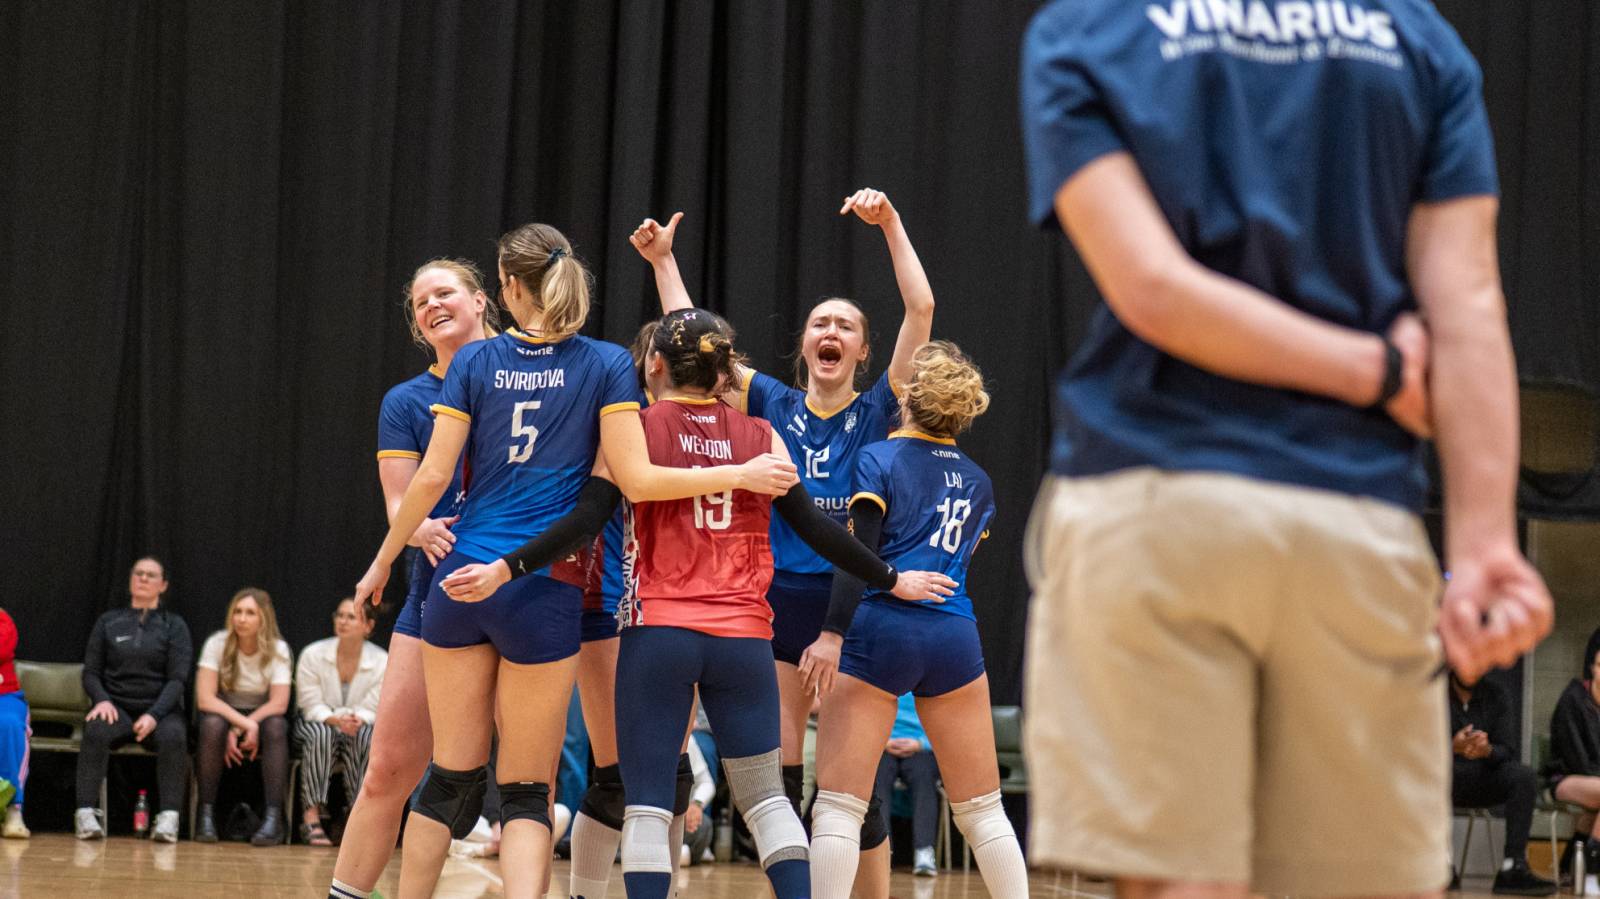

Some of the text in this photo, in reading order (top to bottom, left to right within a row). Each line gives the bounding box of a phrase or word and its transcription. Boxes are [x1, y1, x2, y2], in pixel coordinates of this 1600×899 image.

[1146, 0, 1397, 49] VINARIUS
[494, 368, 564, 391] SVIRIDOVA
[507, 400, 541, 464] 5
[679, 433, 732, 460] WELDON
[802, 445, 830, 478] 12
[944, 471, 962, 489] LAI
[814, 496, 851, 510] RIUS
[929, 497, 971, 554] 18
